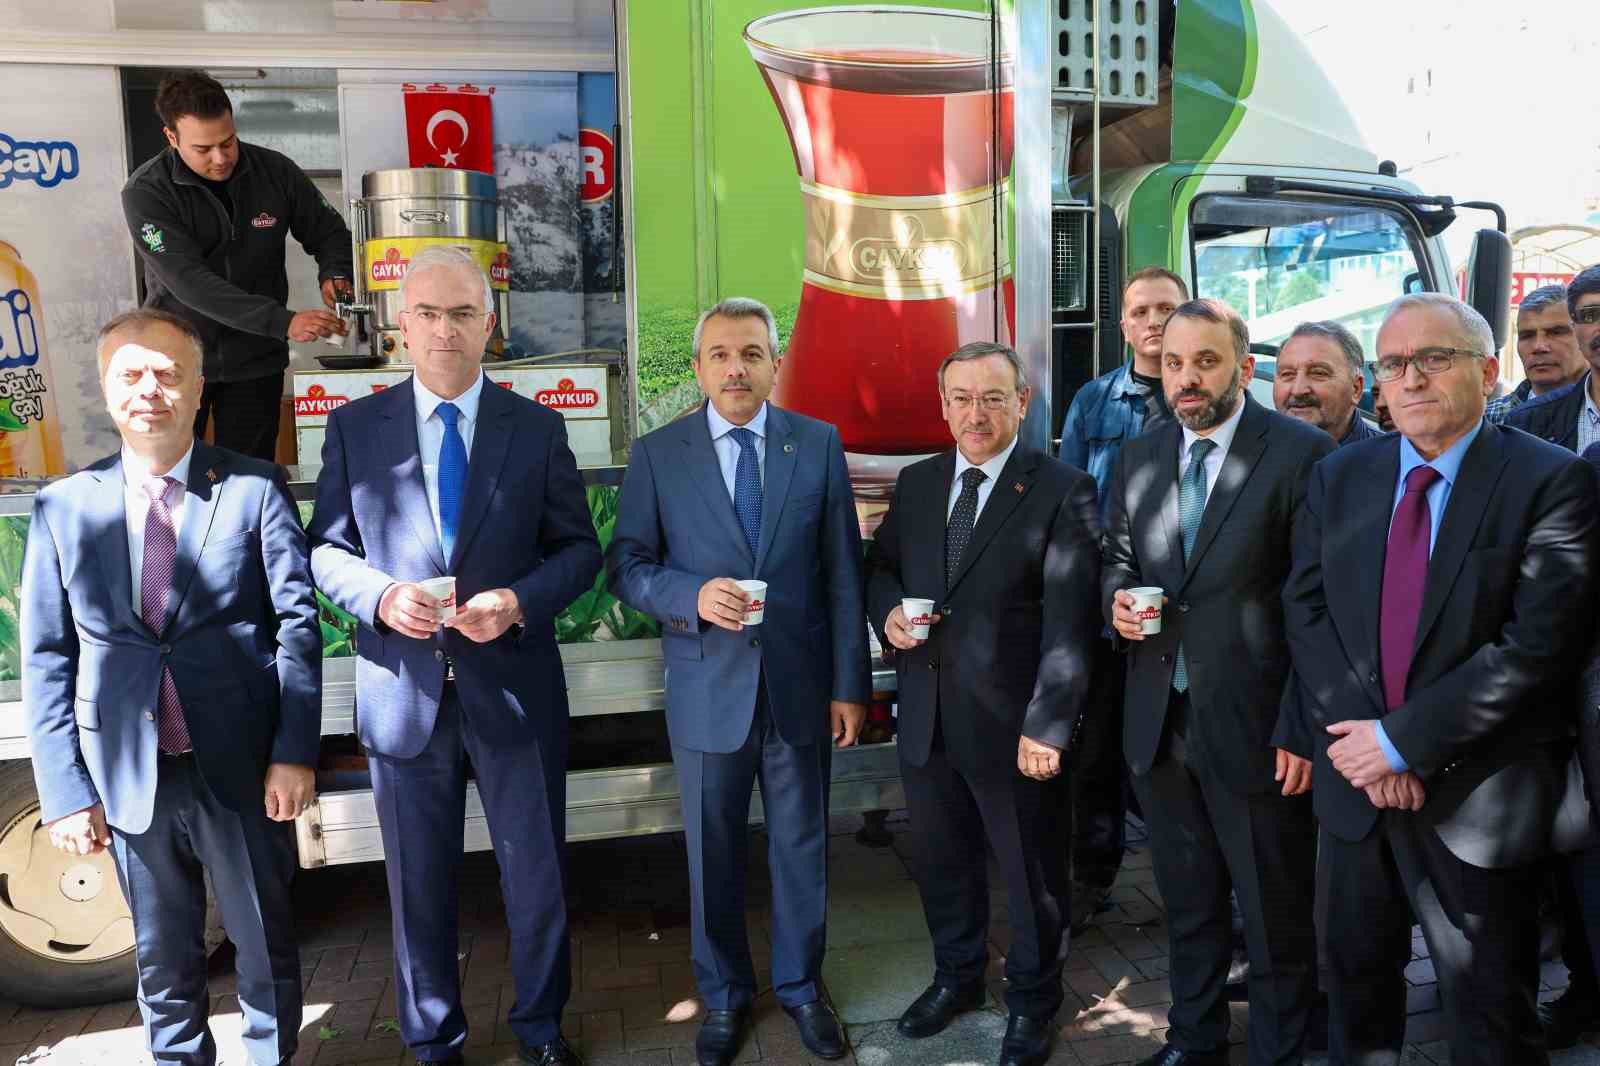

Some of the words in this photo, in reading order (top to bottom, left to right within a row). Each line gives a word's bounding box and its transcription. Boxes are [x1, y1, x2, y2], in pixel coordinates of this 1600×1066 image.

[860, 246, 957, 271] ÇAYK
[372, 264, 411, 280] ÇAYK
[10, 396, 43, 424] çay
